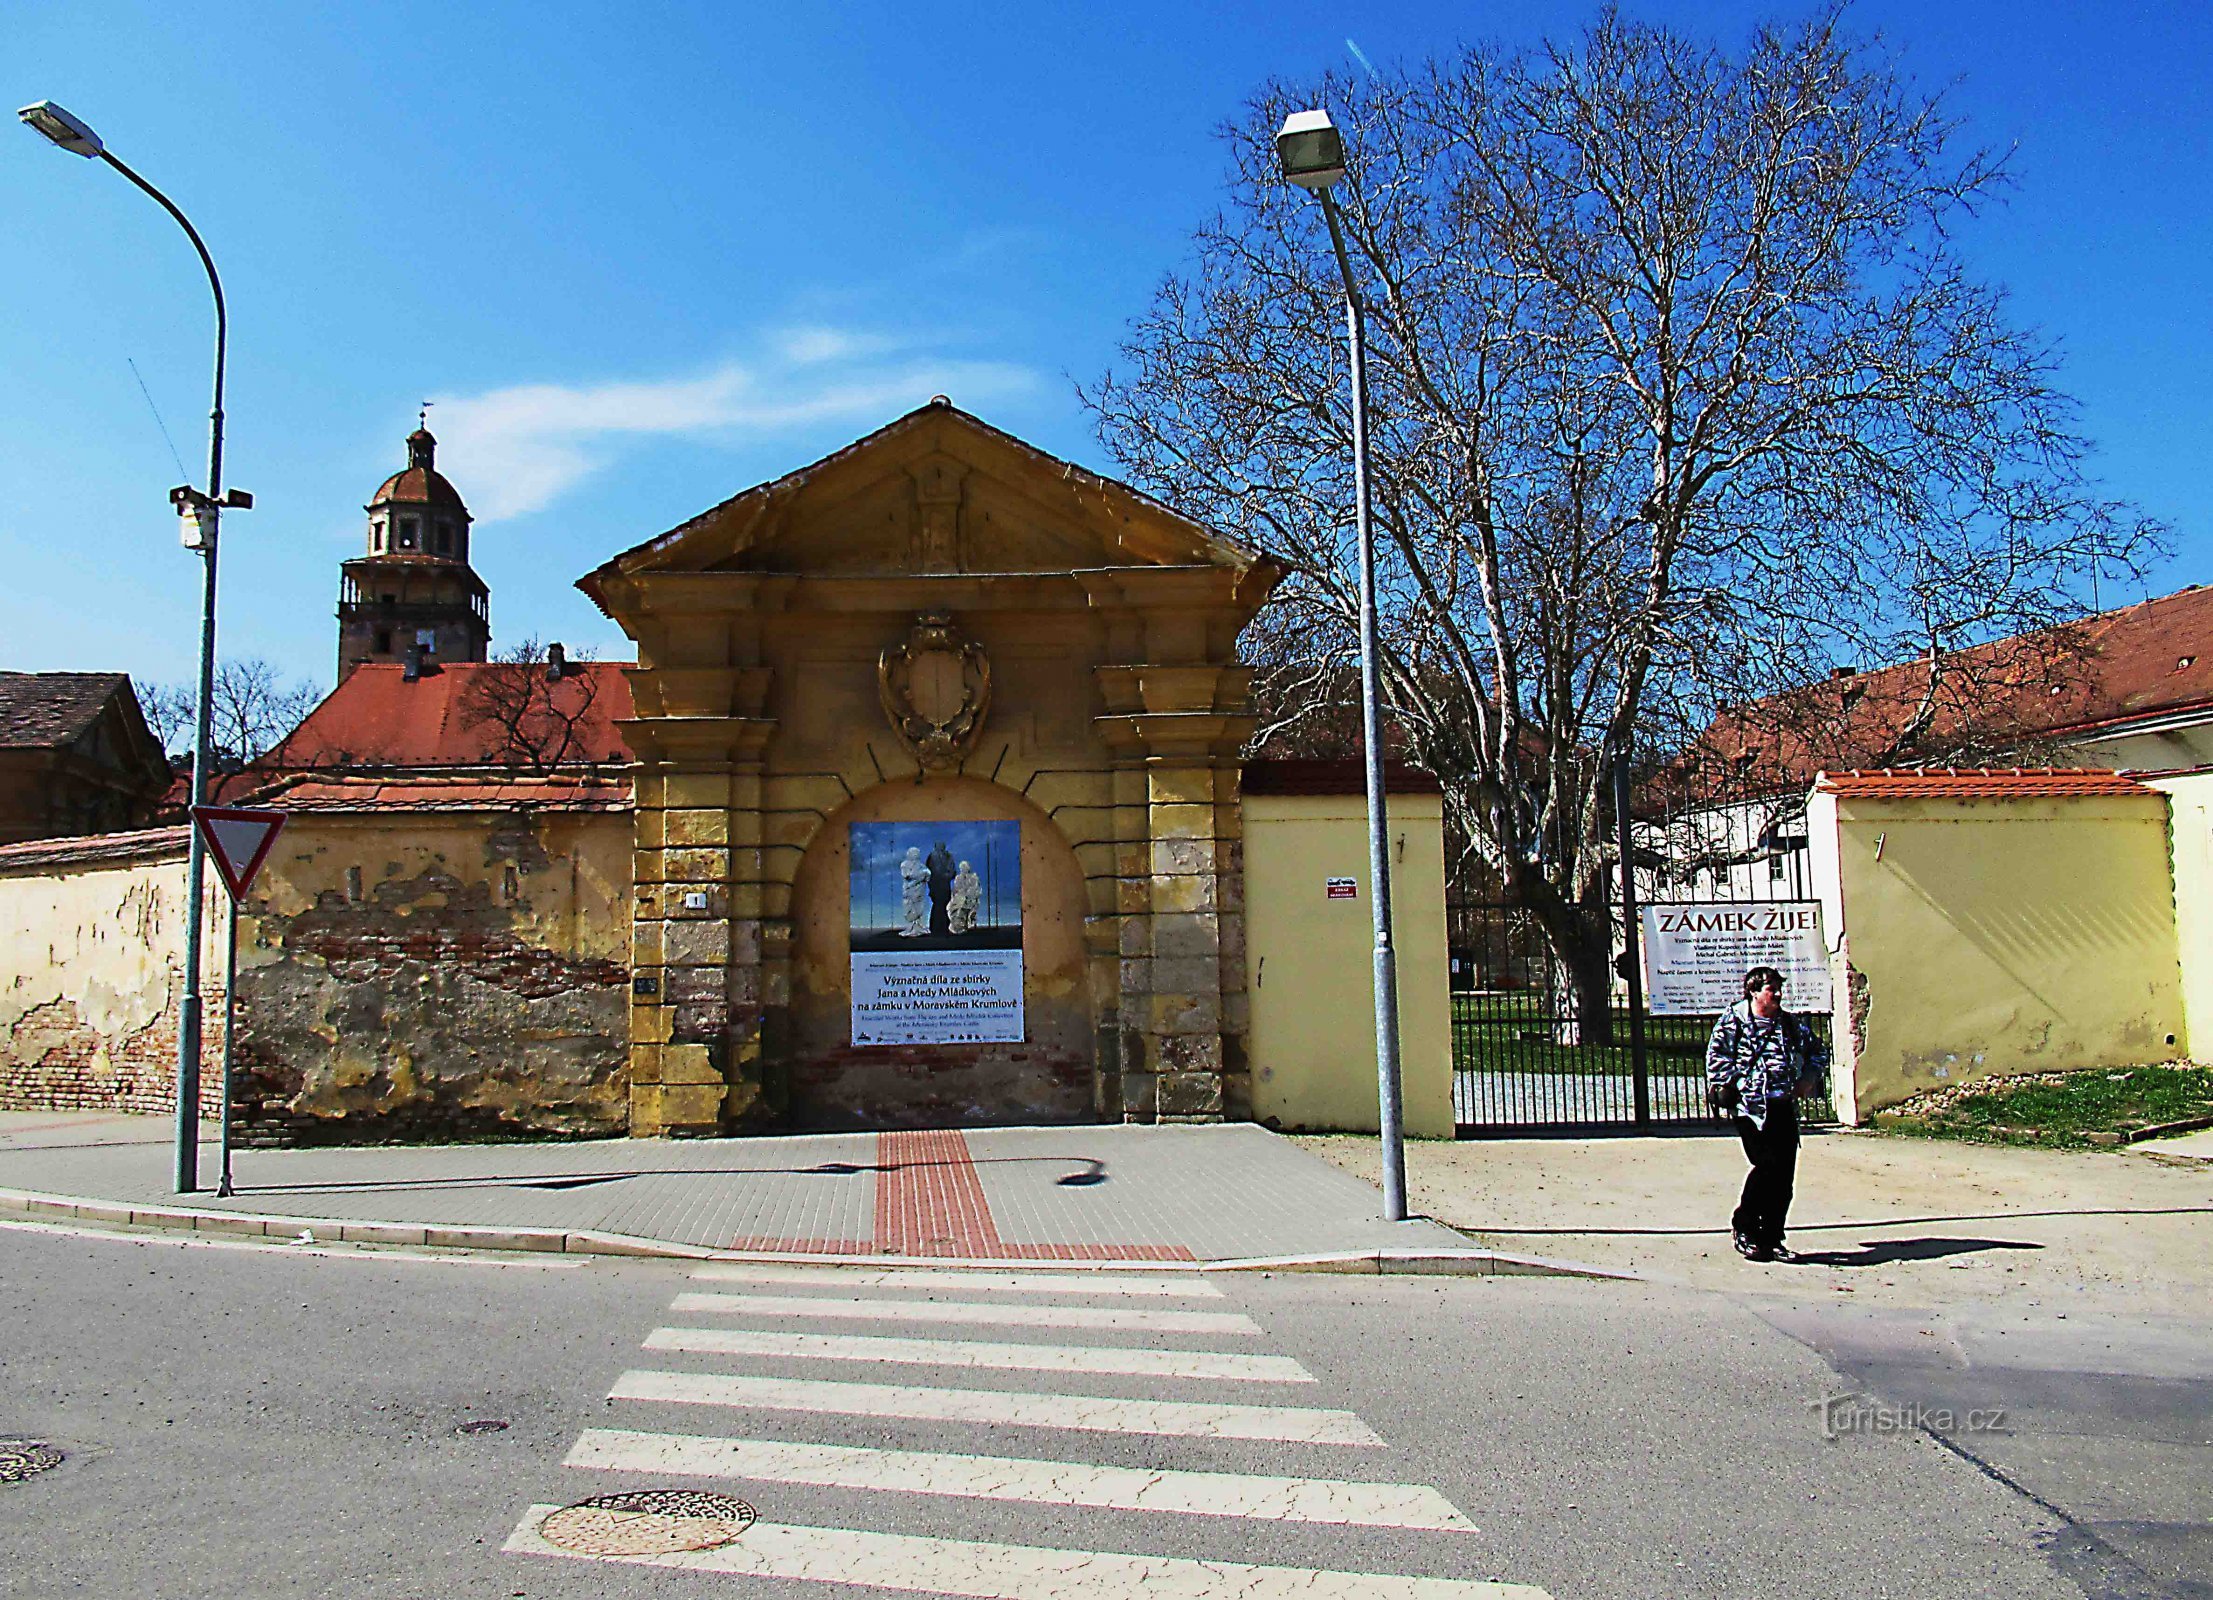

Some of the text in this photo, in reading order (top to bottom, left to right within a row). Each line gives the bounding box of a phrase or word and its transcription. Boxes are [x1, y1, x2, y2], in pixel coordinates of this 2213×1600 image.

[1660, 908, 1817, 932] ZÁMEK ŽIJE!
[884, 974, 991, 987] Význačná díla ze sbírky
[877, 989, 898, 998] Jana
[908, 988, 937, 998] Medy
[939, 987, 996, 998] Mládkových
[858, 998, 1017, 1011] na zámku v Moravském Krumlově
